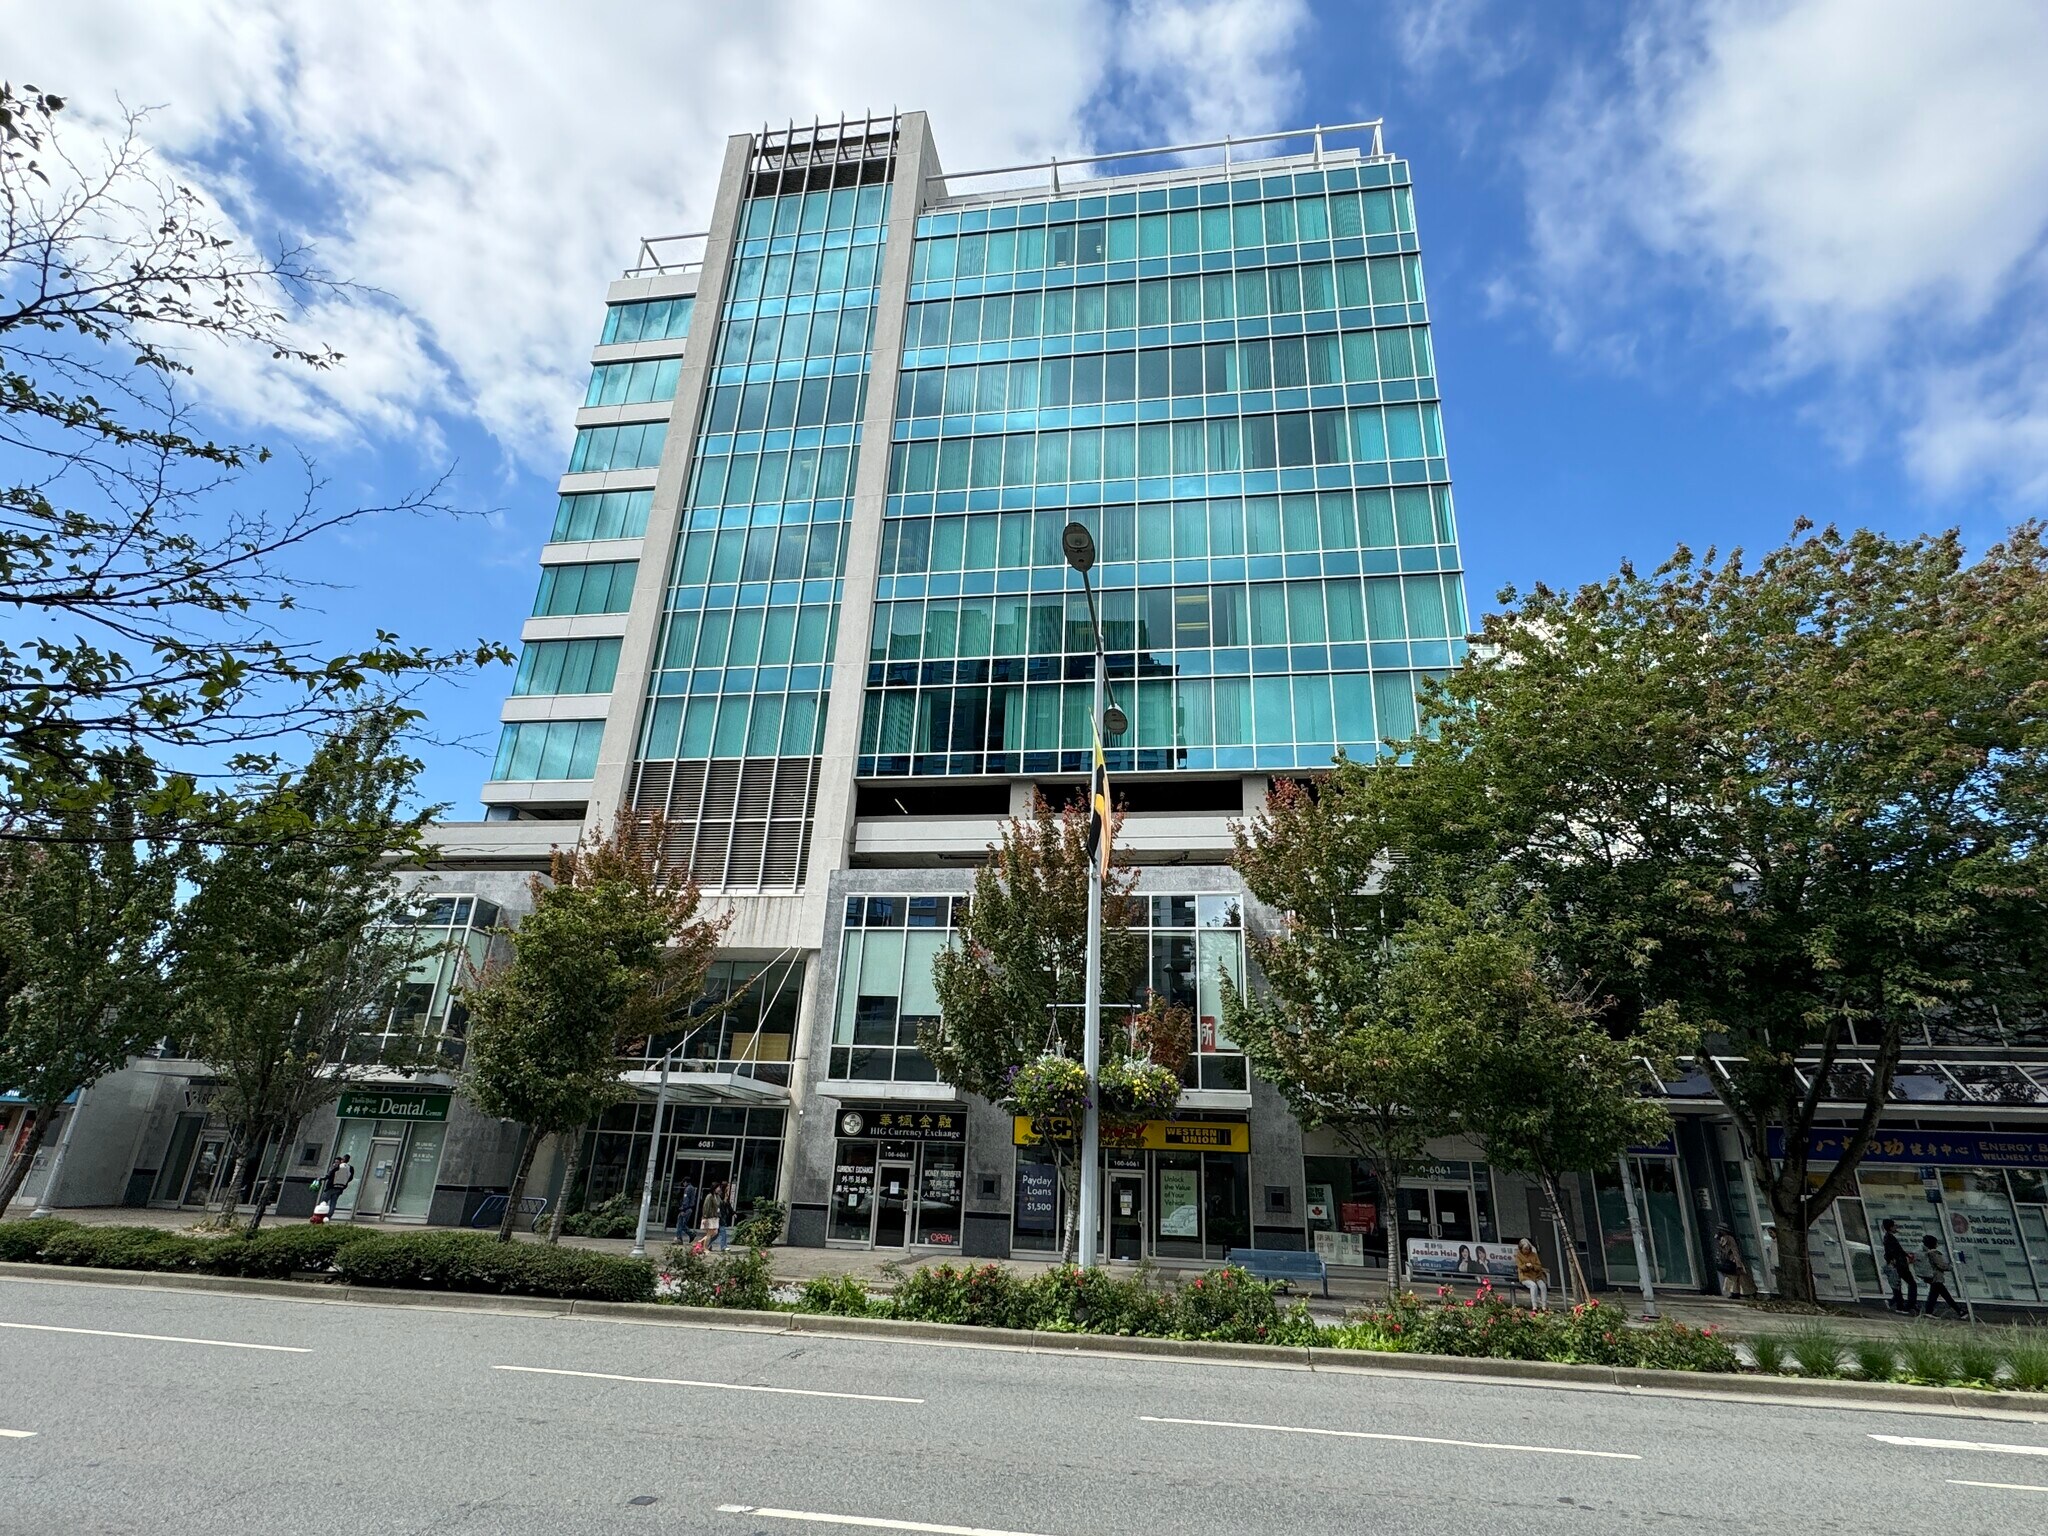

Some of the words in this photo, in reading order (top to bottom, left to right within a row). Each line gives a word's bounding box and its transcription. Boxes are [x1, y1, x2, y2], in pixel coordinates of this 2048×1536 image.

[379, 1097, 426, 1116] Dental
[880, 1113, 952, 1128] 華楓金融
[870, 1127, 886, 1135] HIG
[888, 1127, 922, 1138] Currency
[925, 1128, 960, 1139] Exchange
[1166, 1128, 1217, 1136] WESTERN
[698, 1140, 714, 1148] 6081
[1182, 1135, 1217, 1144] UNION
[1978, 1141, 2032, 1152] ENERGY
[1981, 1153, 2029, 1162] WELLNESS
[1022, 1174, 1052, 1187] Payday
[1027, 1186, 1052, 1196] Loans
[1027, 1202, 1052, 1212] $1,500
[930, 1233, 952, 1243] OPEN
[1991, 1237, 2016, 1246] SOON
[1412, 1248, 1439, 1257] Jessica
[1440, 1249, 1457, 1258] Hsia
[1489, 1253, 1512, 1261] Grace
